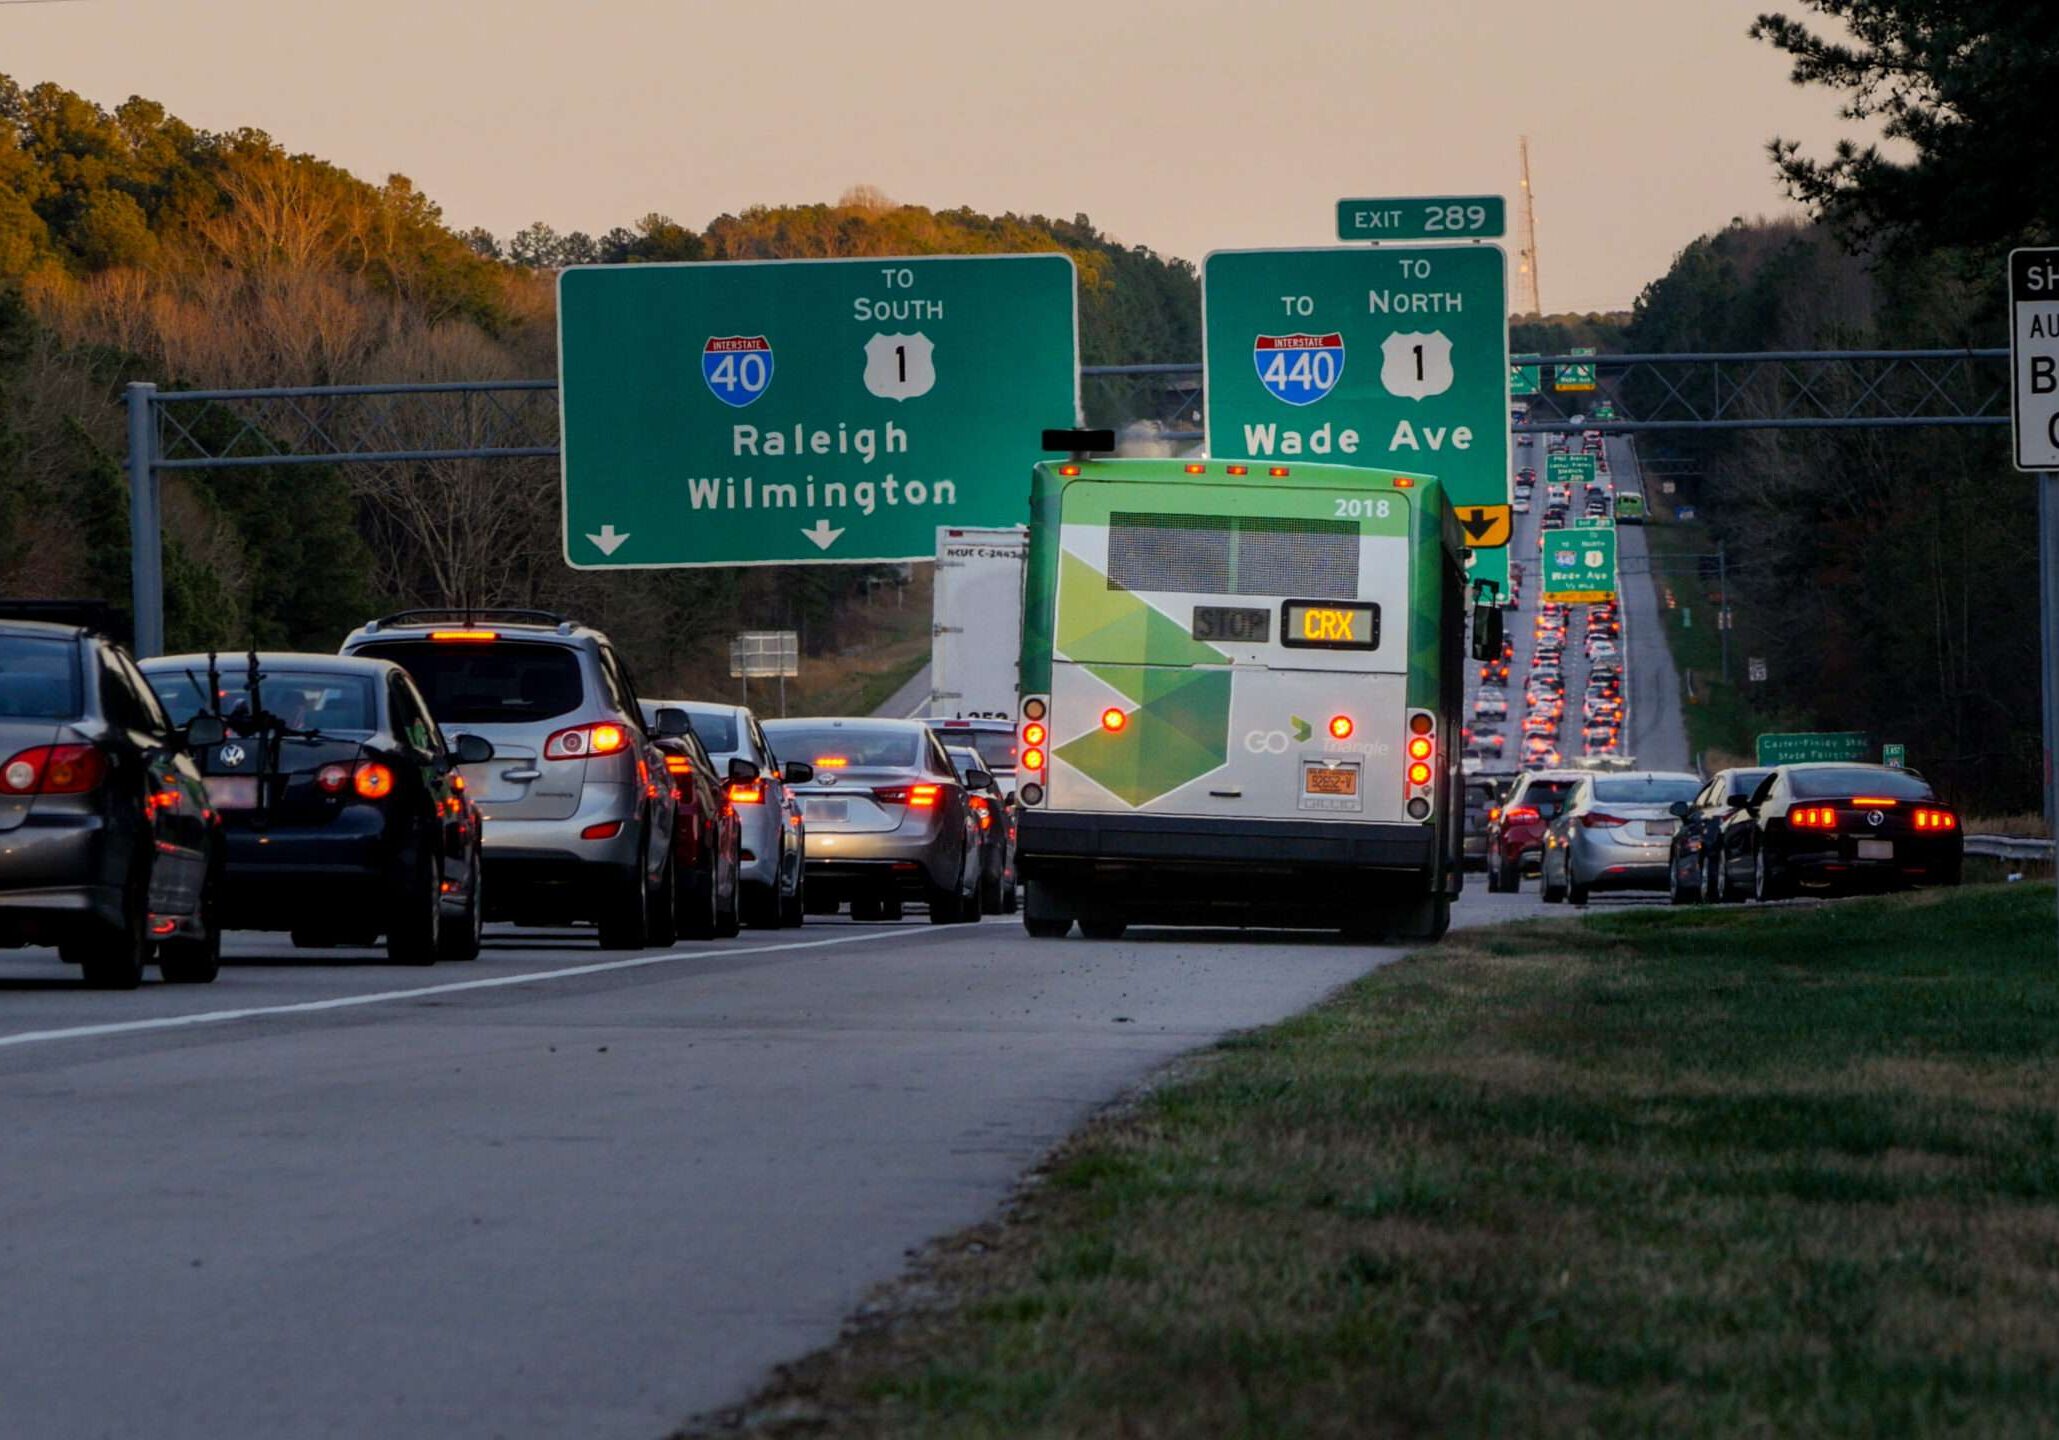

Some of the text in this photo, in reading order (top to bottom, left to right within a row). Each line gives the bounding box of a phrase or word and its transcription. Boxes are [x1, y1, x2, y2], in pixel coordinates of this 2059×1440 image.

[1355, 205, 1486, 231] EXIT 289
[881, 269, 914, 289] TO
[1399, 259, 1431, 279] TO
[854, 298, 944, 321] SOUTH
[1281, 296, 1314, 316] TO
[1369, 289, 1462, 313] NORTH
[712, 340, 761, 351] INTERSTATE
[1273, 338, 1324, 348] INTERSTATE
[710, 354, 766, 393] 40
[895, 346, 906, 382] 1
[1264, 351, 1335, 391] 440
[1413, 345, 1424, 381] 1
[733, 421, 908, 464] Raleigh
[1243, 420, 1473, 456] Wade Ave
[687, 473, 957, 515] Wilmington
[1334, 499, 1390, 518] 2018
[1199, 608, 1265, 638] STOP
[1304, 607, 1355, 640] CRX
[1245, 730, 1290, 754] GO
